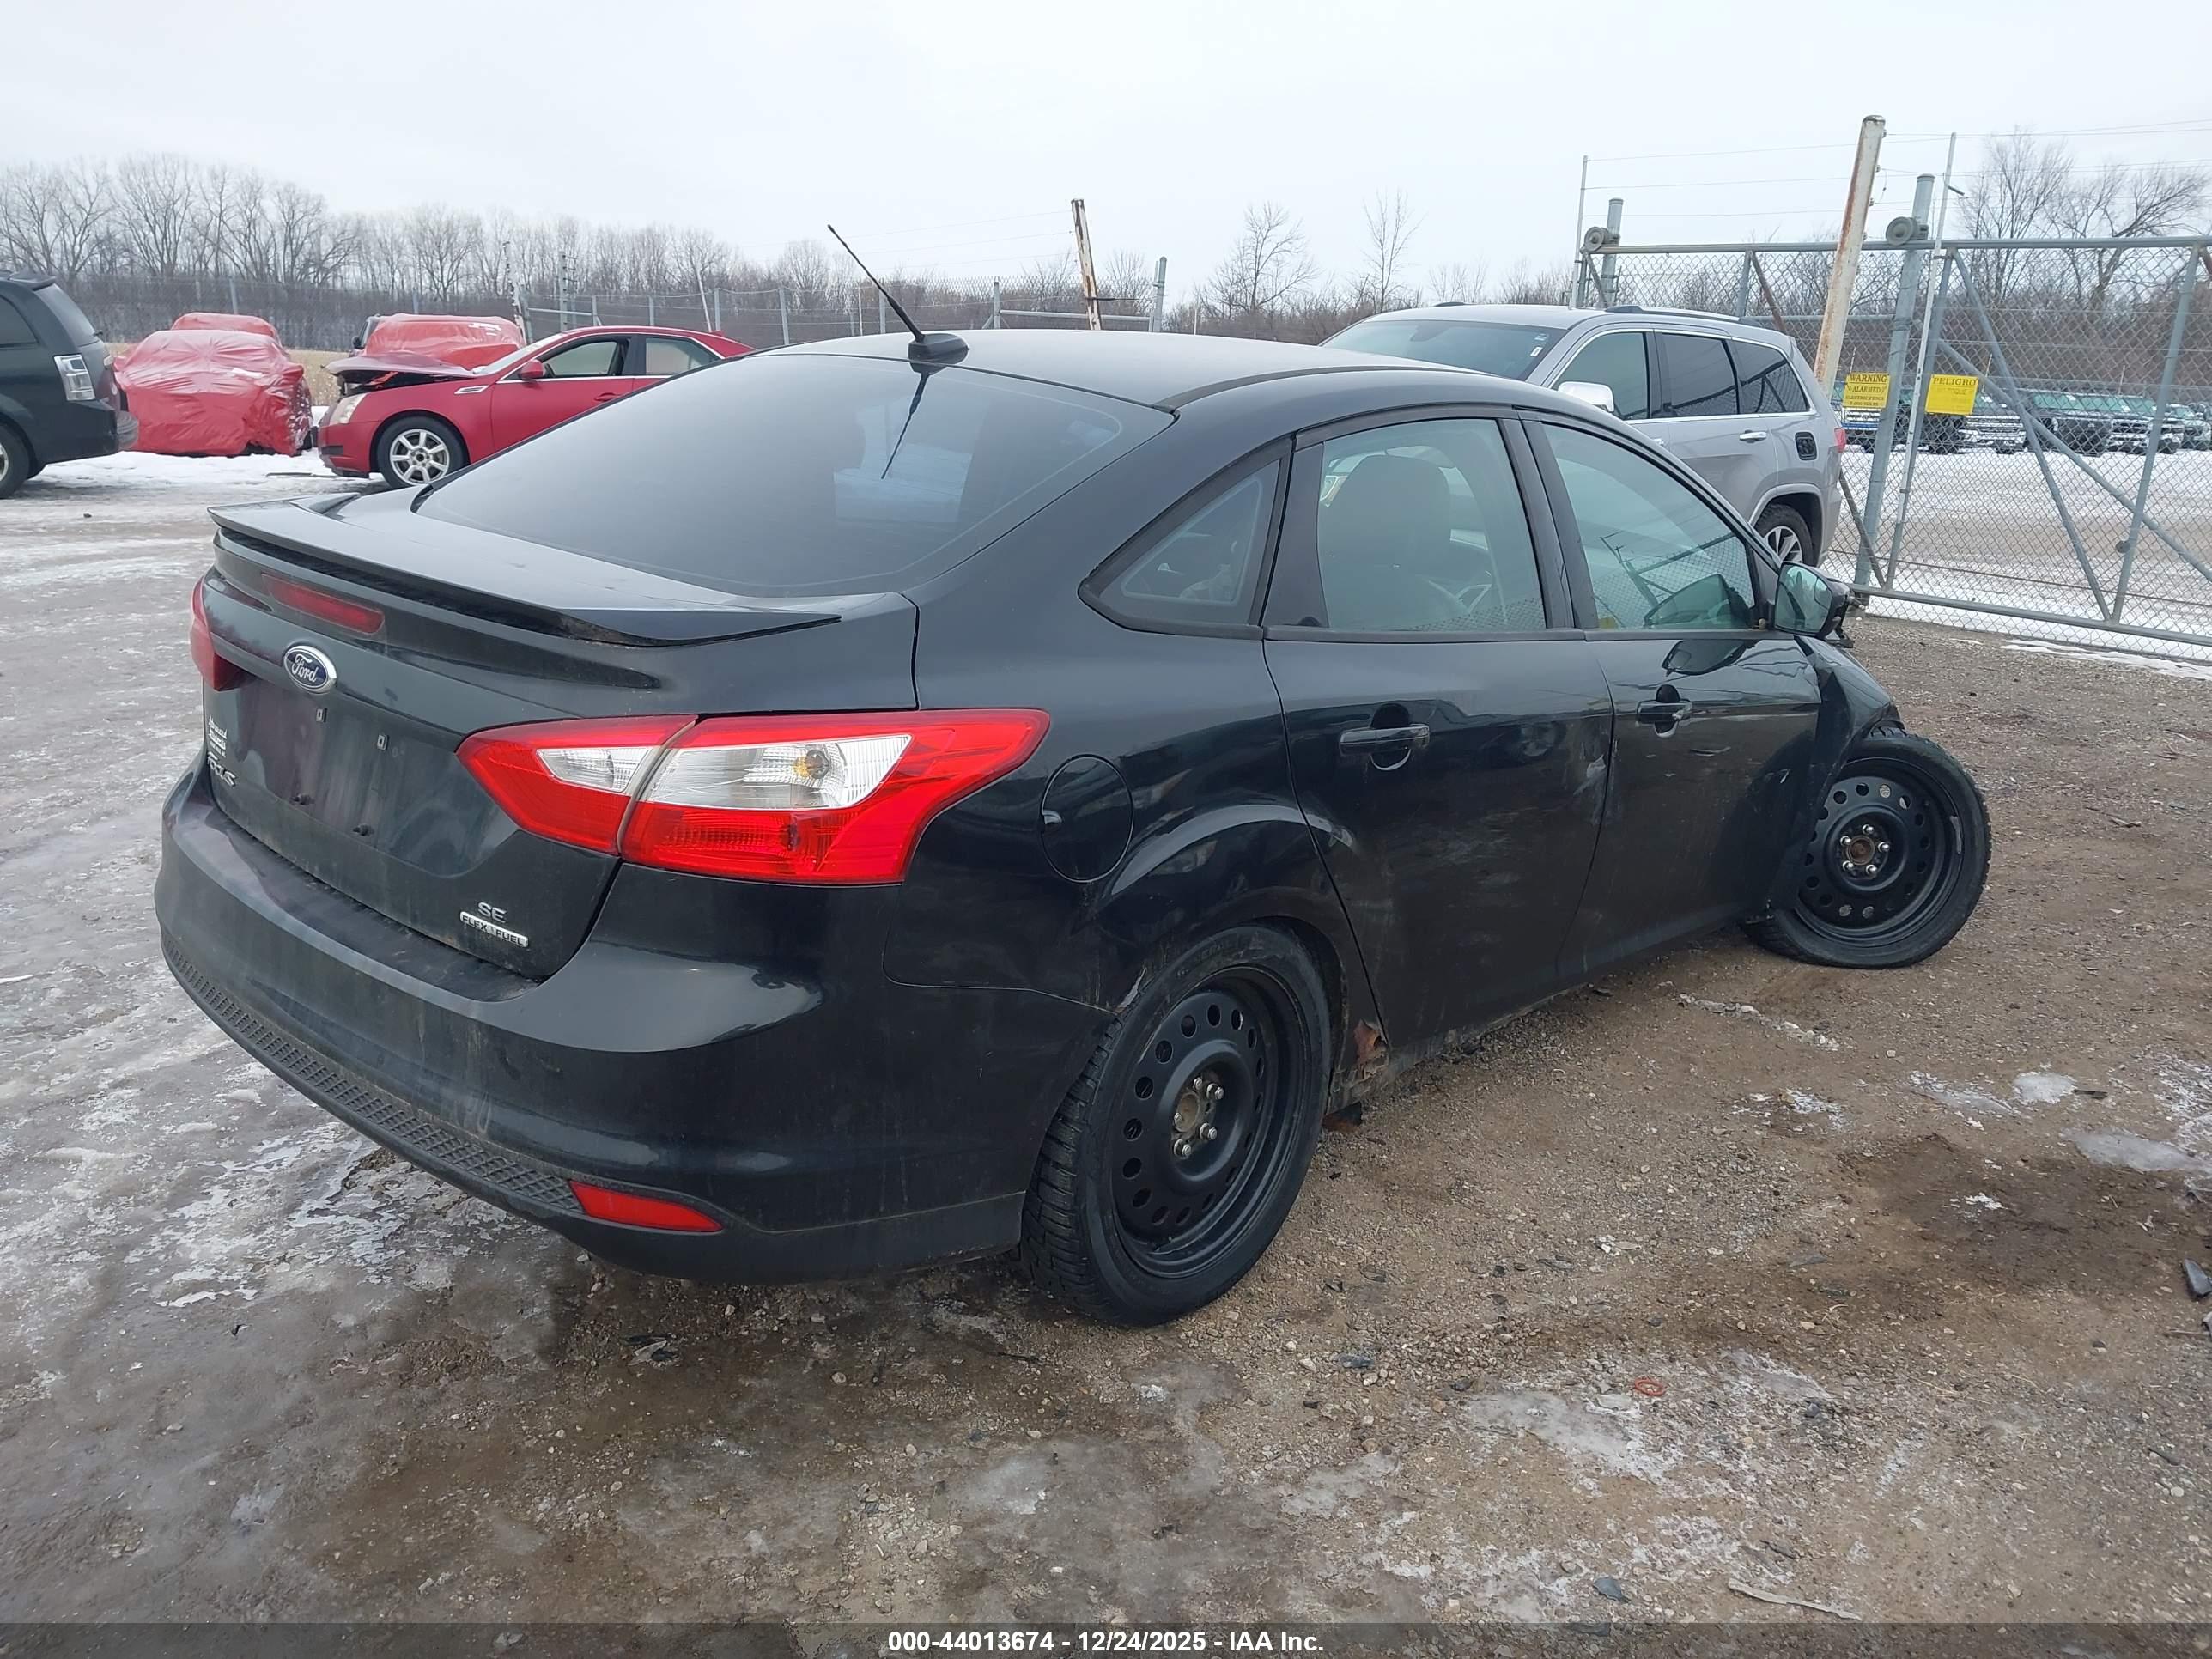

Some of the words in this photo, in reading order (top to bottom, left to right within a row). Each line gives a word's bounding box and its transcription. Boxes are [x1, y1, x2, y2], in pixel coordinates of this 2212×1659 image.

[1850, 374, 1887, 383] WARNING
[1933, 377, 1976, 386] PELIGRO
[291, 653, 319, 683] Ford
[478, 902, 507, 924] SE
[462, 914, 488, 933] FLEX
[495, 929, 526, 946] FUEL
